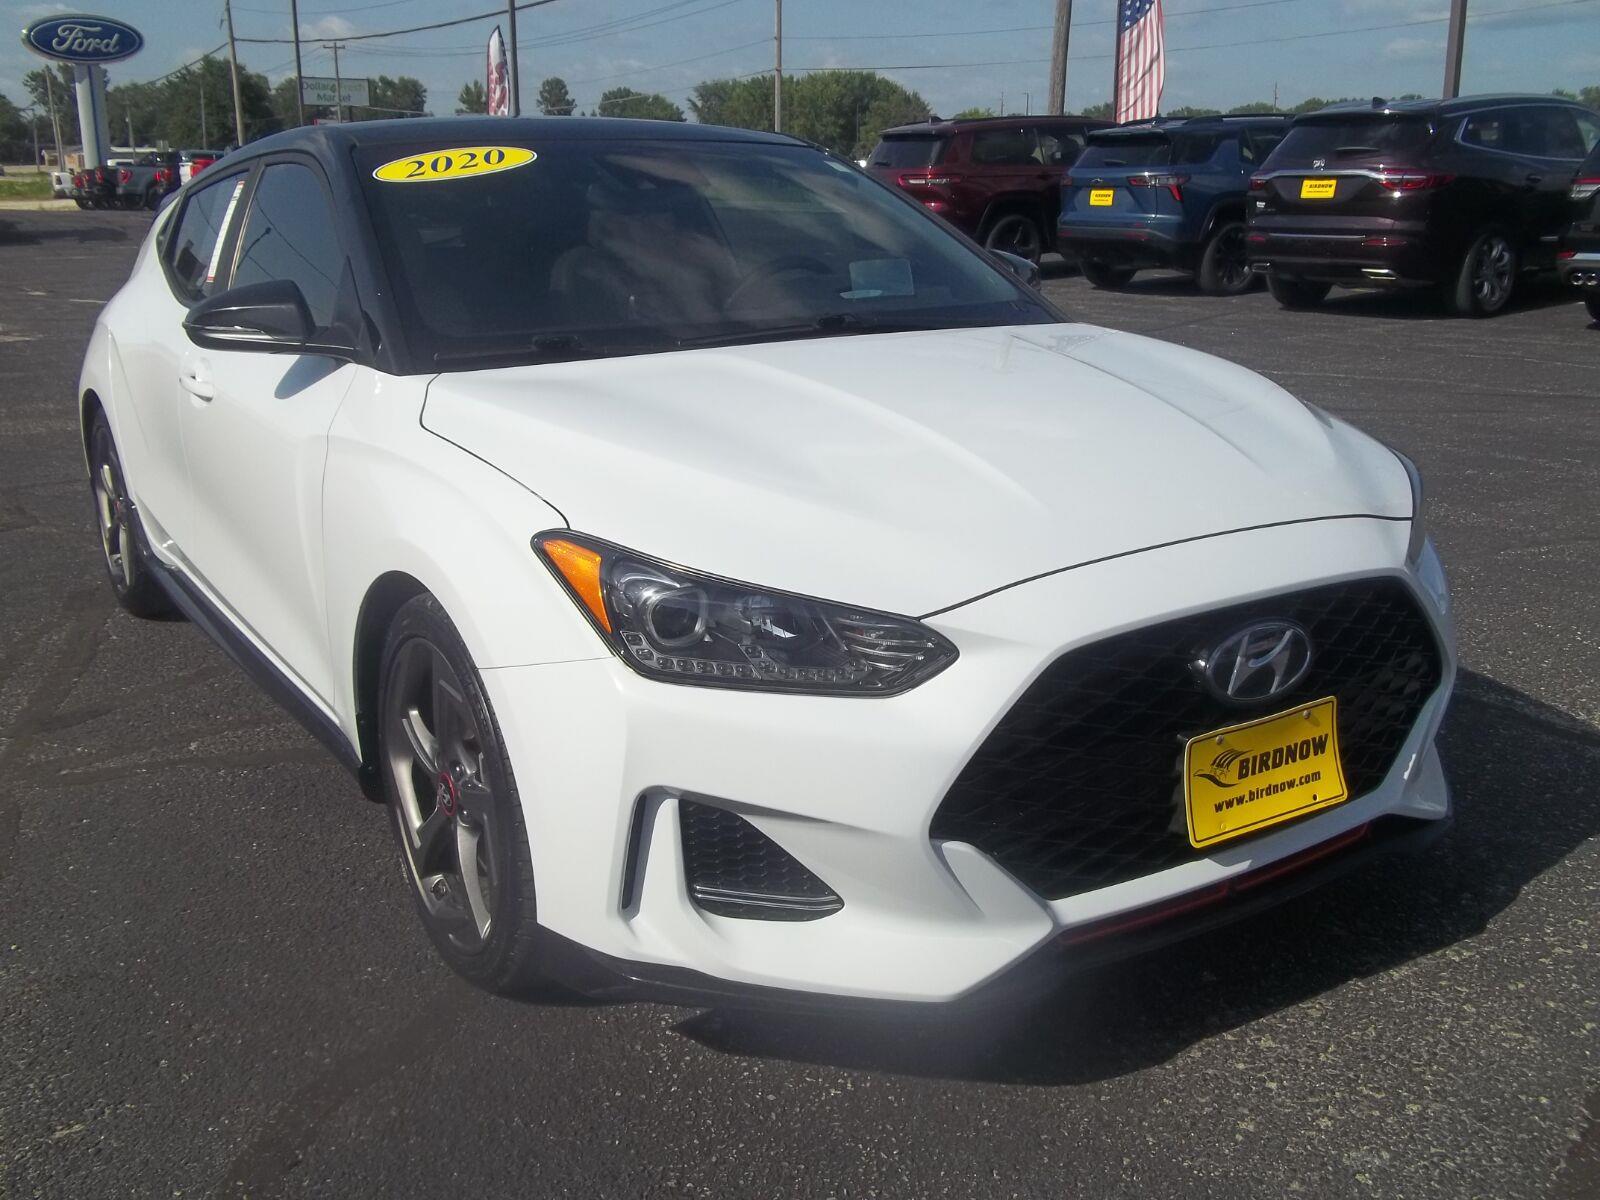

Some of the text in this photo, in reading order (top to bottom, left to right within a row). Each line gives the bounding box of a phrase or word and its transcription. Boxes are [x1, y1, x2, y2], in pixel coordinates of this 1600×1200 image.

[52, 24, 120, 53] Ford
[404, 149, 506, 179] 2020
[1237, 733, 1329, 780] BIRDNOW
[1214, 770, 1321, 813] www.birdnow.com
